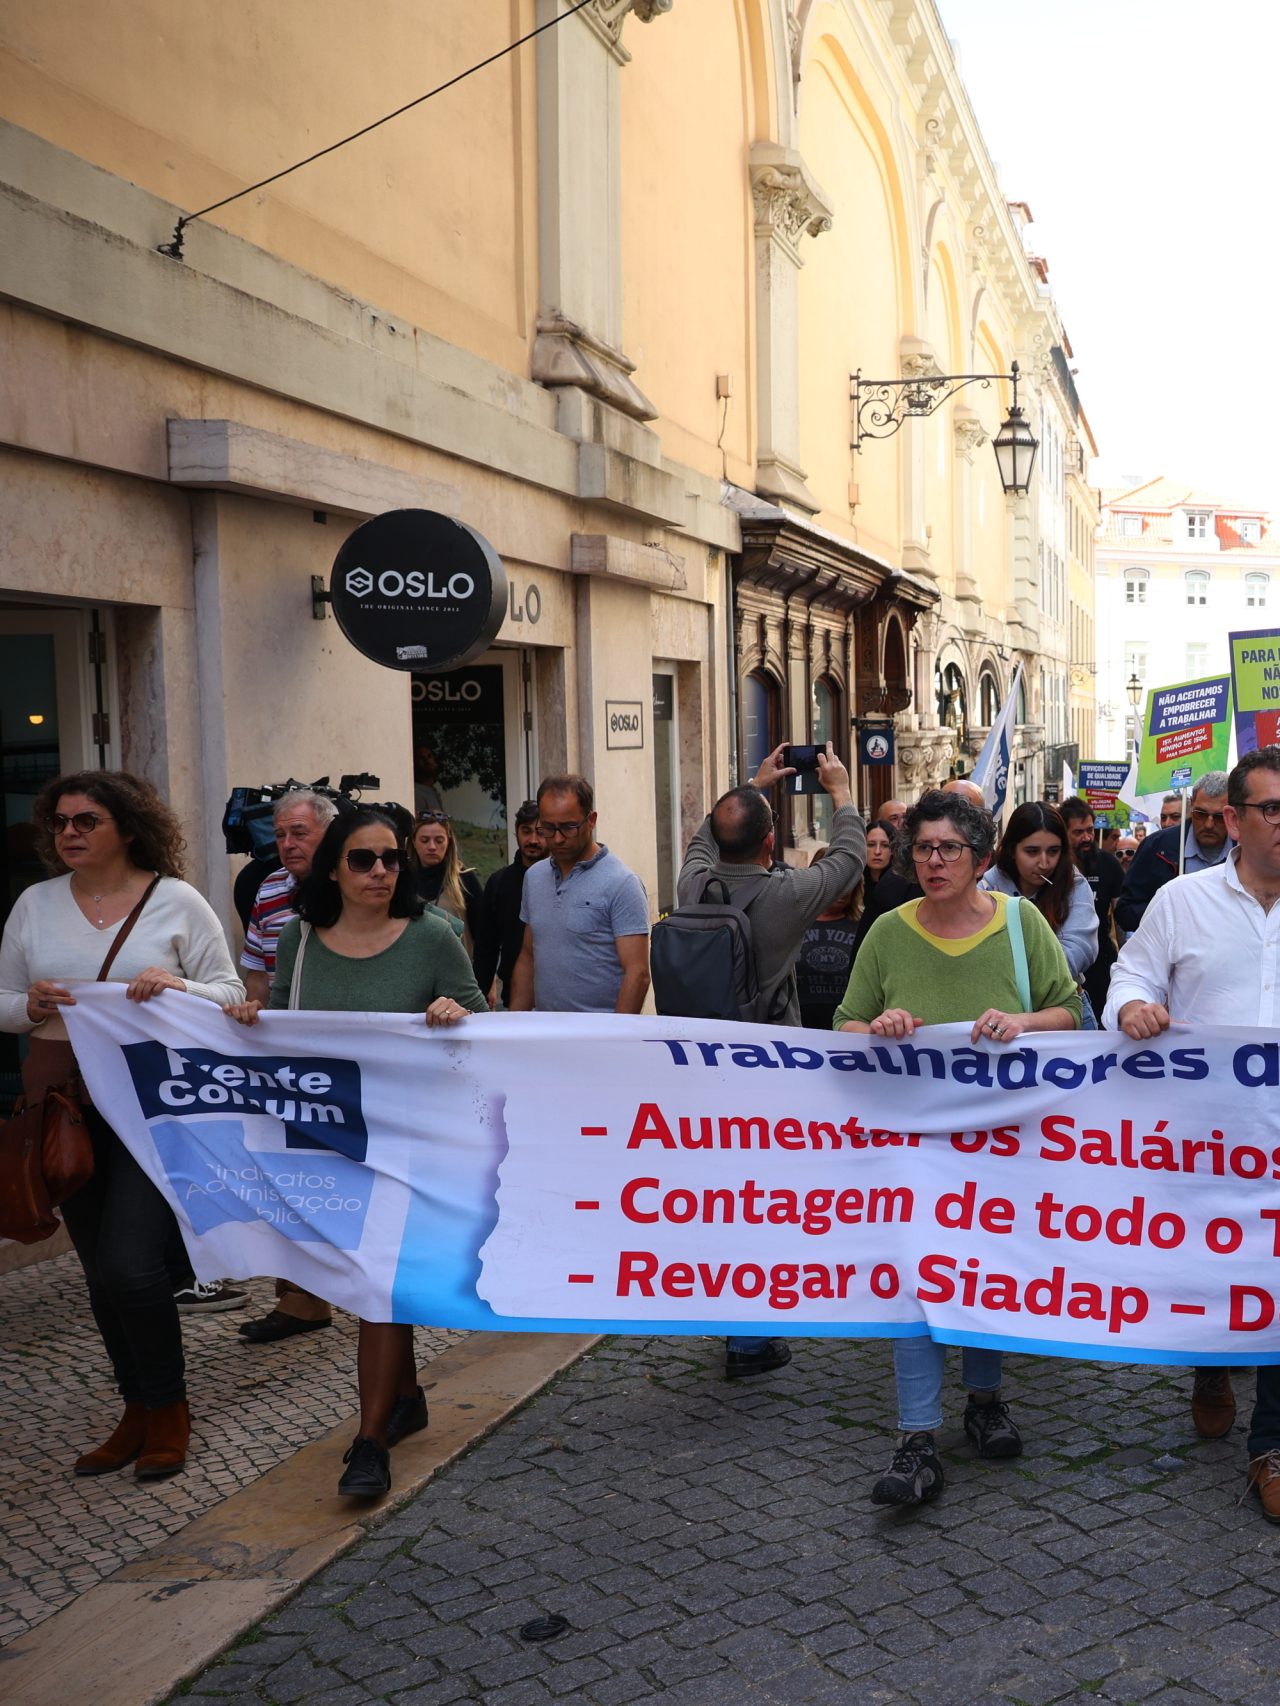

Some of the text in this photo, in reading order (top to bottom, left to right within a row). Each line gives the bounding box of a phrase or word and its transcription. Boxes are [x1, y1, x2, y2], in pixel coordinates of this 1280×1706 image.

[378, 570, 475, 599] OSLO
[510, 582, 541, 624] LO
[1241, 648, 1276, 664] PARA
[1158, 685, 1223, 706] NÃO ACEITAMOS
[1163, 698, 1215, 717] EMPOBRECER
[617, 714, 638, 731] OSLO
[1159, 709, 1217, 729] A TRABALHAR
[826, 929, 856, 945] YOR
[644, 1039, 1210, 1090] Trabalhadores
[626, 1103, 925, 1151] Aumentar
[950, 1125, 1020, 1157] os
[620, 1177, 915, 1235] Contagem
[934, 1181, 1016, 1234] de
[1035, 1192, 1186, 1250] todo
[1205, 1214, 1243, 1255] o
[616, 1250, 856, 1310] Revogar
[870, 1268, 899, 1299] o
[916, 1253, 1149, 1334] Siadap
